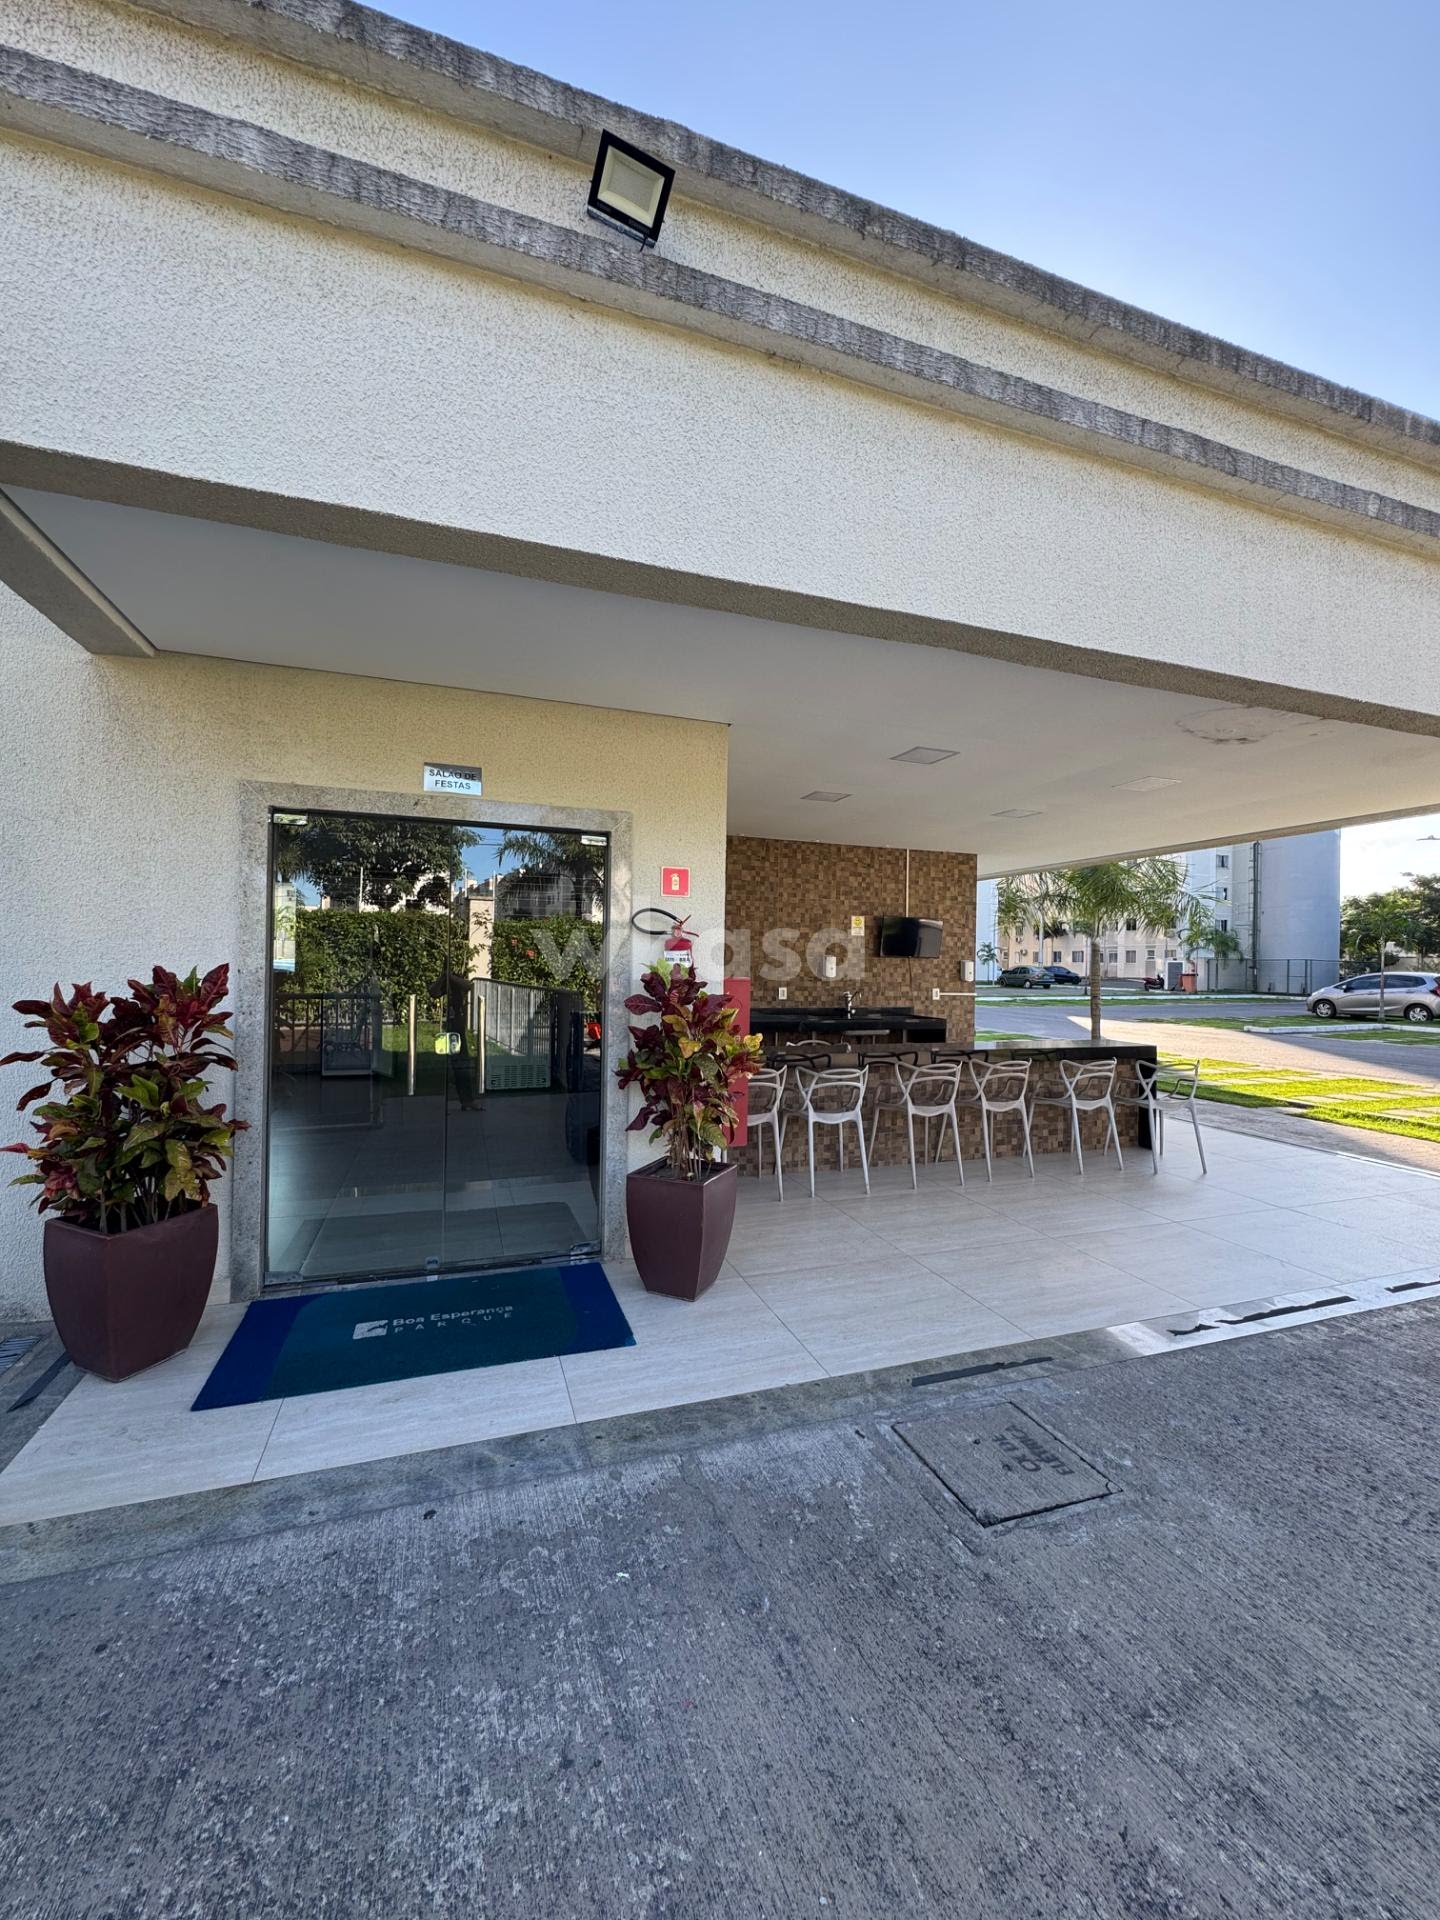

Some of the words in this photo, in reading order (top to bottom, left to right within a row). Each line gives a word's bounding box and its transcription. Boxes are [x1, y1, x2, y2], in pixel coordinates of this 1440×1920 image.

[429, 768, 462, 779] SALÃO
[464, 772, 477, 780] DE
[435, 779, 472, 790] FESTAS
[393, 1317, 425, 1326] Boa
[431, 1305, 513, 1321] Esperança
[395, 1312, 512, 1333] PARQUE
